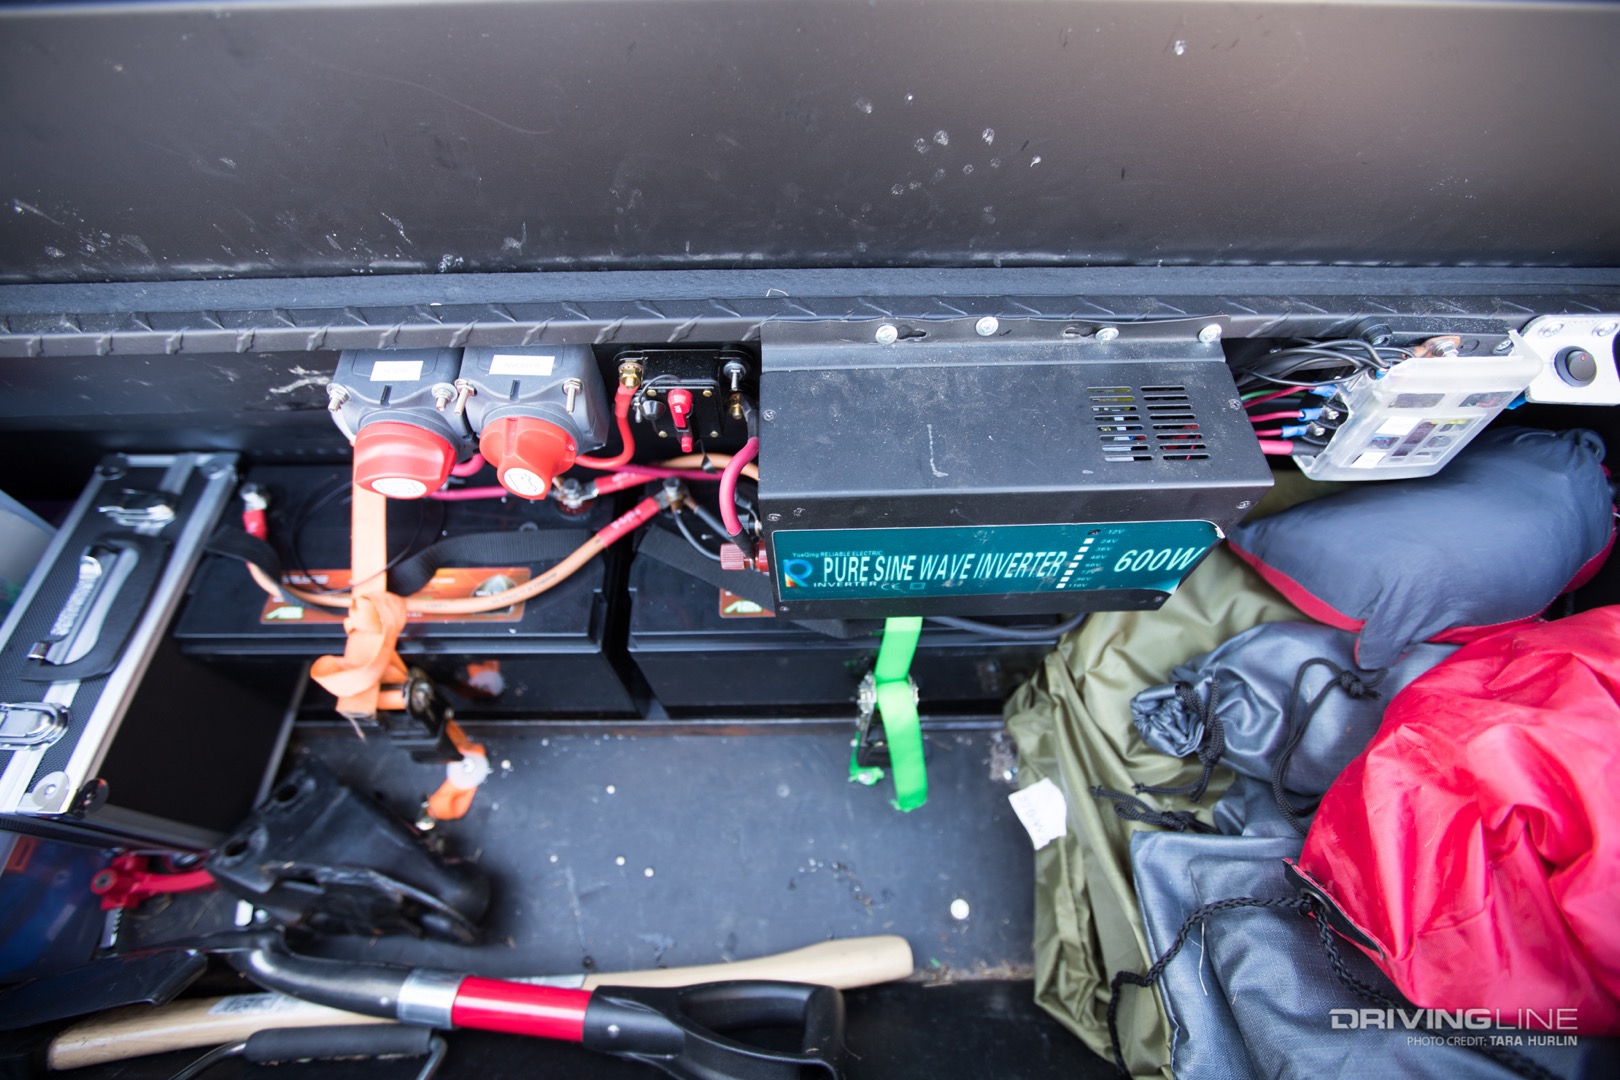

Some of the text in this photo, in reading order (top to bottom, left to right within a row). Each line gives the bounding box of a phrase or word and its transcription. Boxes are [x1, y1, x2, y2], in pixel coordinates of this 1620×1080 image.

[823, 551, 1068, 582] PURE SINE WAVE INVERTER
[1114, 547, 1206, 572] 600W
